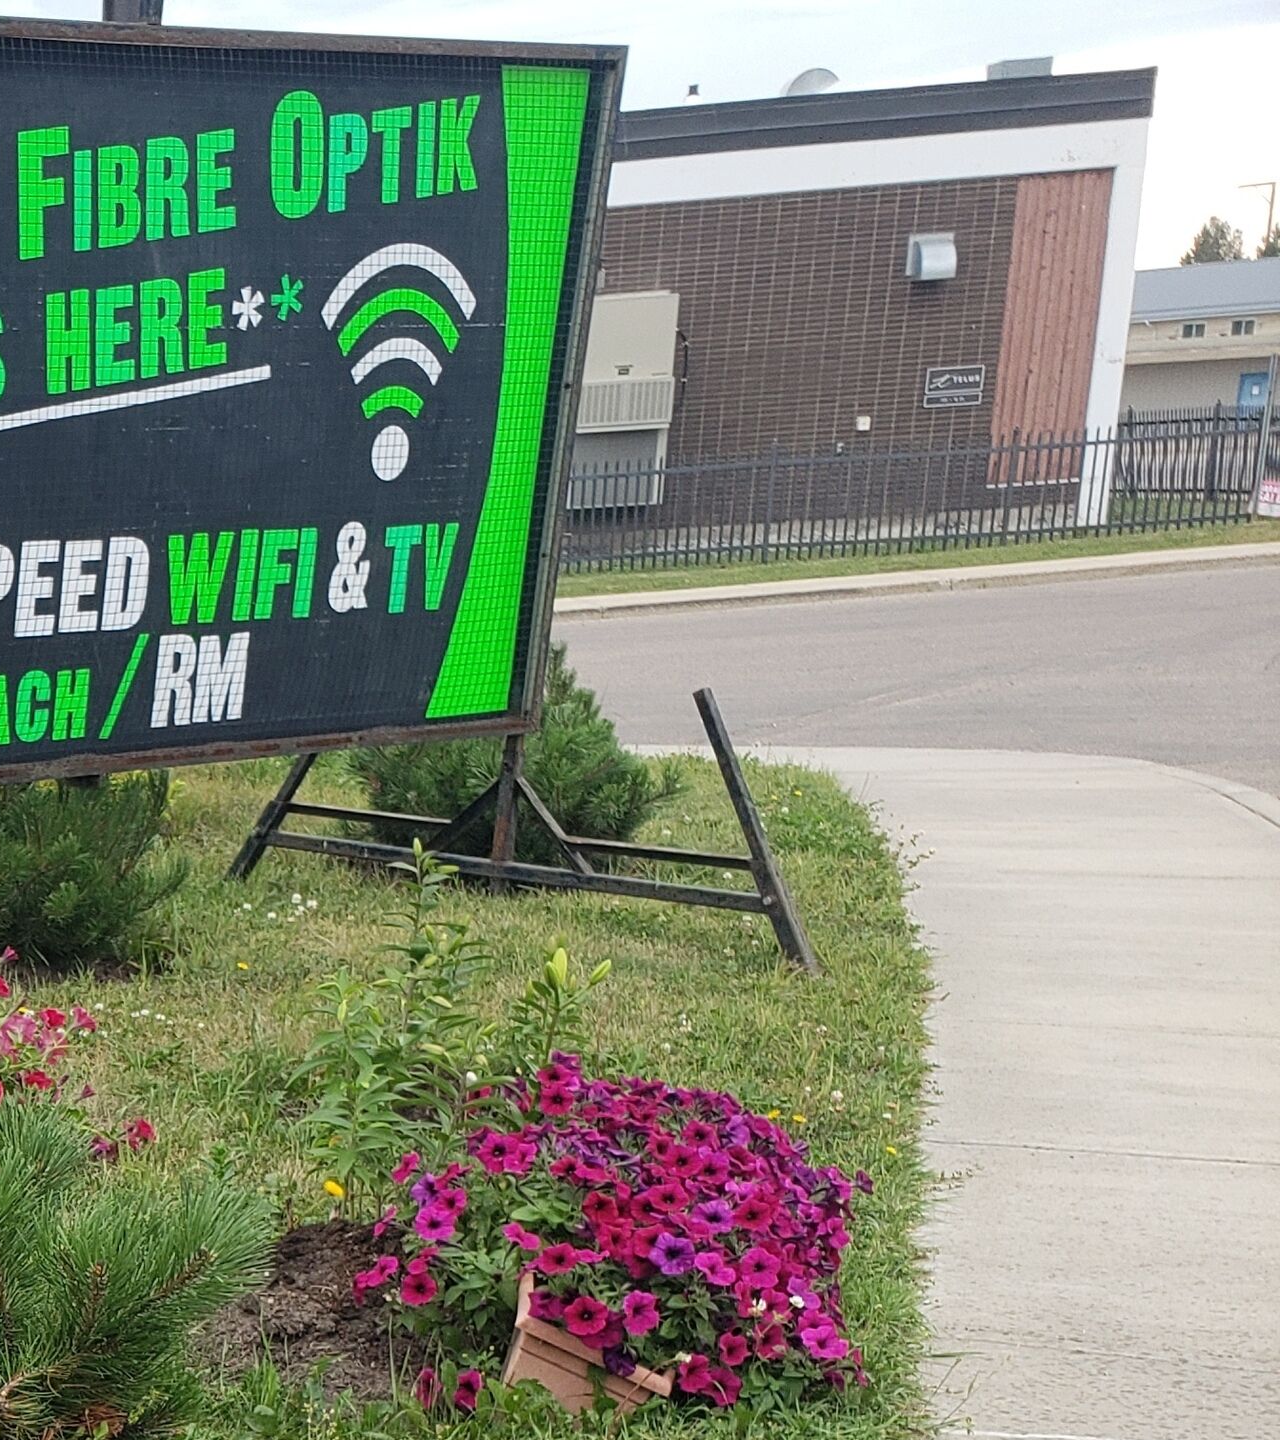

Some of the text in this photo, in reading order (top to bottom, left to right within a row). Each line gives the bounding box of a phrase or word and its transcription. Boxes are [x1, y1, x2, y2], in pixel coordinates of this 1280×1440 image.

[167, 526, 318, 626] WIFI
[327, 521, 371, 613] &
[384, 522, 460, 615] TV
